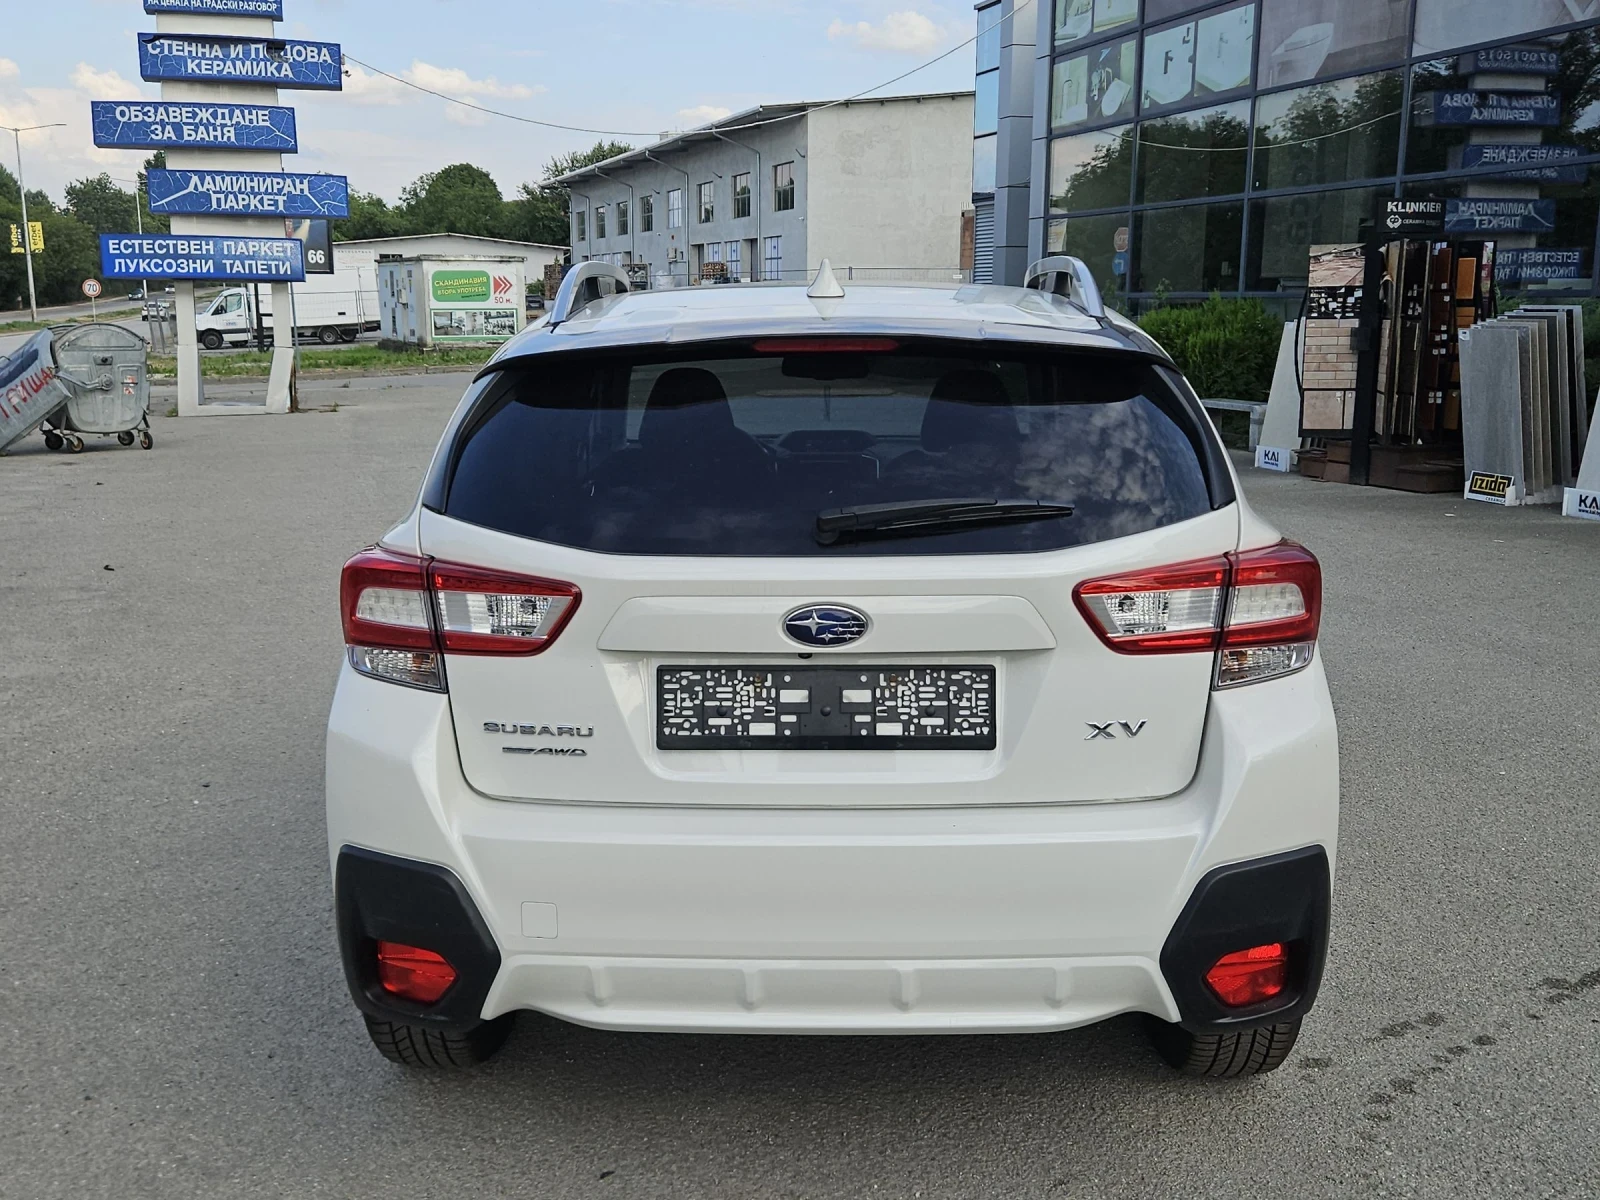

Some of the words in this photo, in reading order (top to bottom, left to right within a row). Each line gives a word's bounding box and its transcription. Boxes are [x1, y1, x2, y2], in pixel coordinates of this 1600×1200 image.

[203, 0, 237, 10] ГРАДСКИ
[147, 40, 221, 58] СТЕННА
[230, 44, 243, 58] И
[187, 60, 294, 78] КЕРАМИКА
[115, 105, 269, 126] ОБЗАВЕЖДАНЕ
[150, 125, 178, 141] ЗА
[183, 125, 235, 143] БАНЯ
[188, 175, 310, 195] ЛАМИНИРАН
[211, 194, 287, 211] ПАРКЕТ
[1386, 201, 1442, 213] KLINKIER
[108, 239, 214, 255] ЕСТЕСТВЕН
[223, 241, 294, 256] ПАРКЕТ
[307, 249, 325, 264] 66
[113, 258, 214, 274] ЛУКСОЗНИ
[222, 260, 291, 275] ТАПЕТИ
[87, 283, 97, 292] 70
[434, 276, 487, 287] СКАНДИНАВИЯ
[437, 288, 456, 296] ВТОРА
[457, 287, 486, 295] УПОТРЕБА
[494, 296, 503, 304] 50
[1264, 449, 1280, 462] KAI
[1578, 494, 1600, 510] KA
[483, 722, 594, 737] SUBARU
[1084, 718, 1149, 741] XV
[533, 747, 588, 757] AWD
